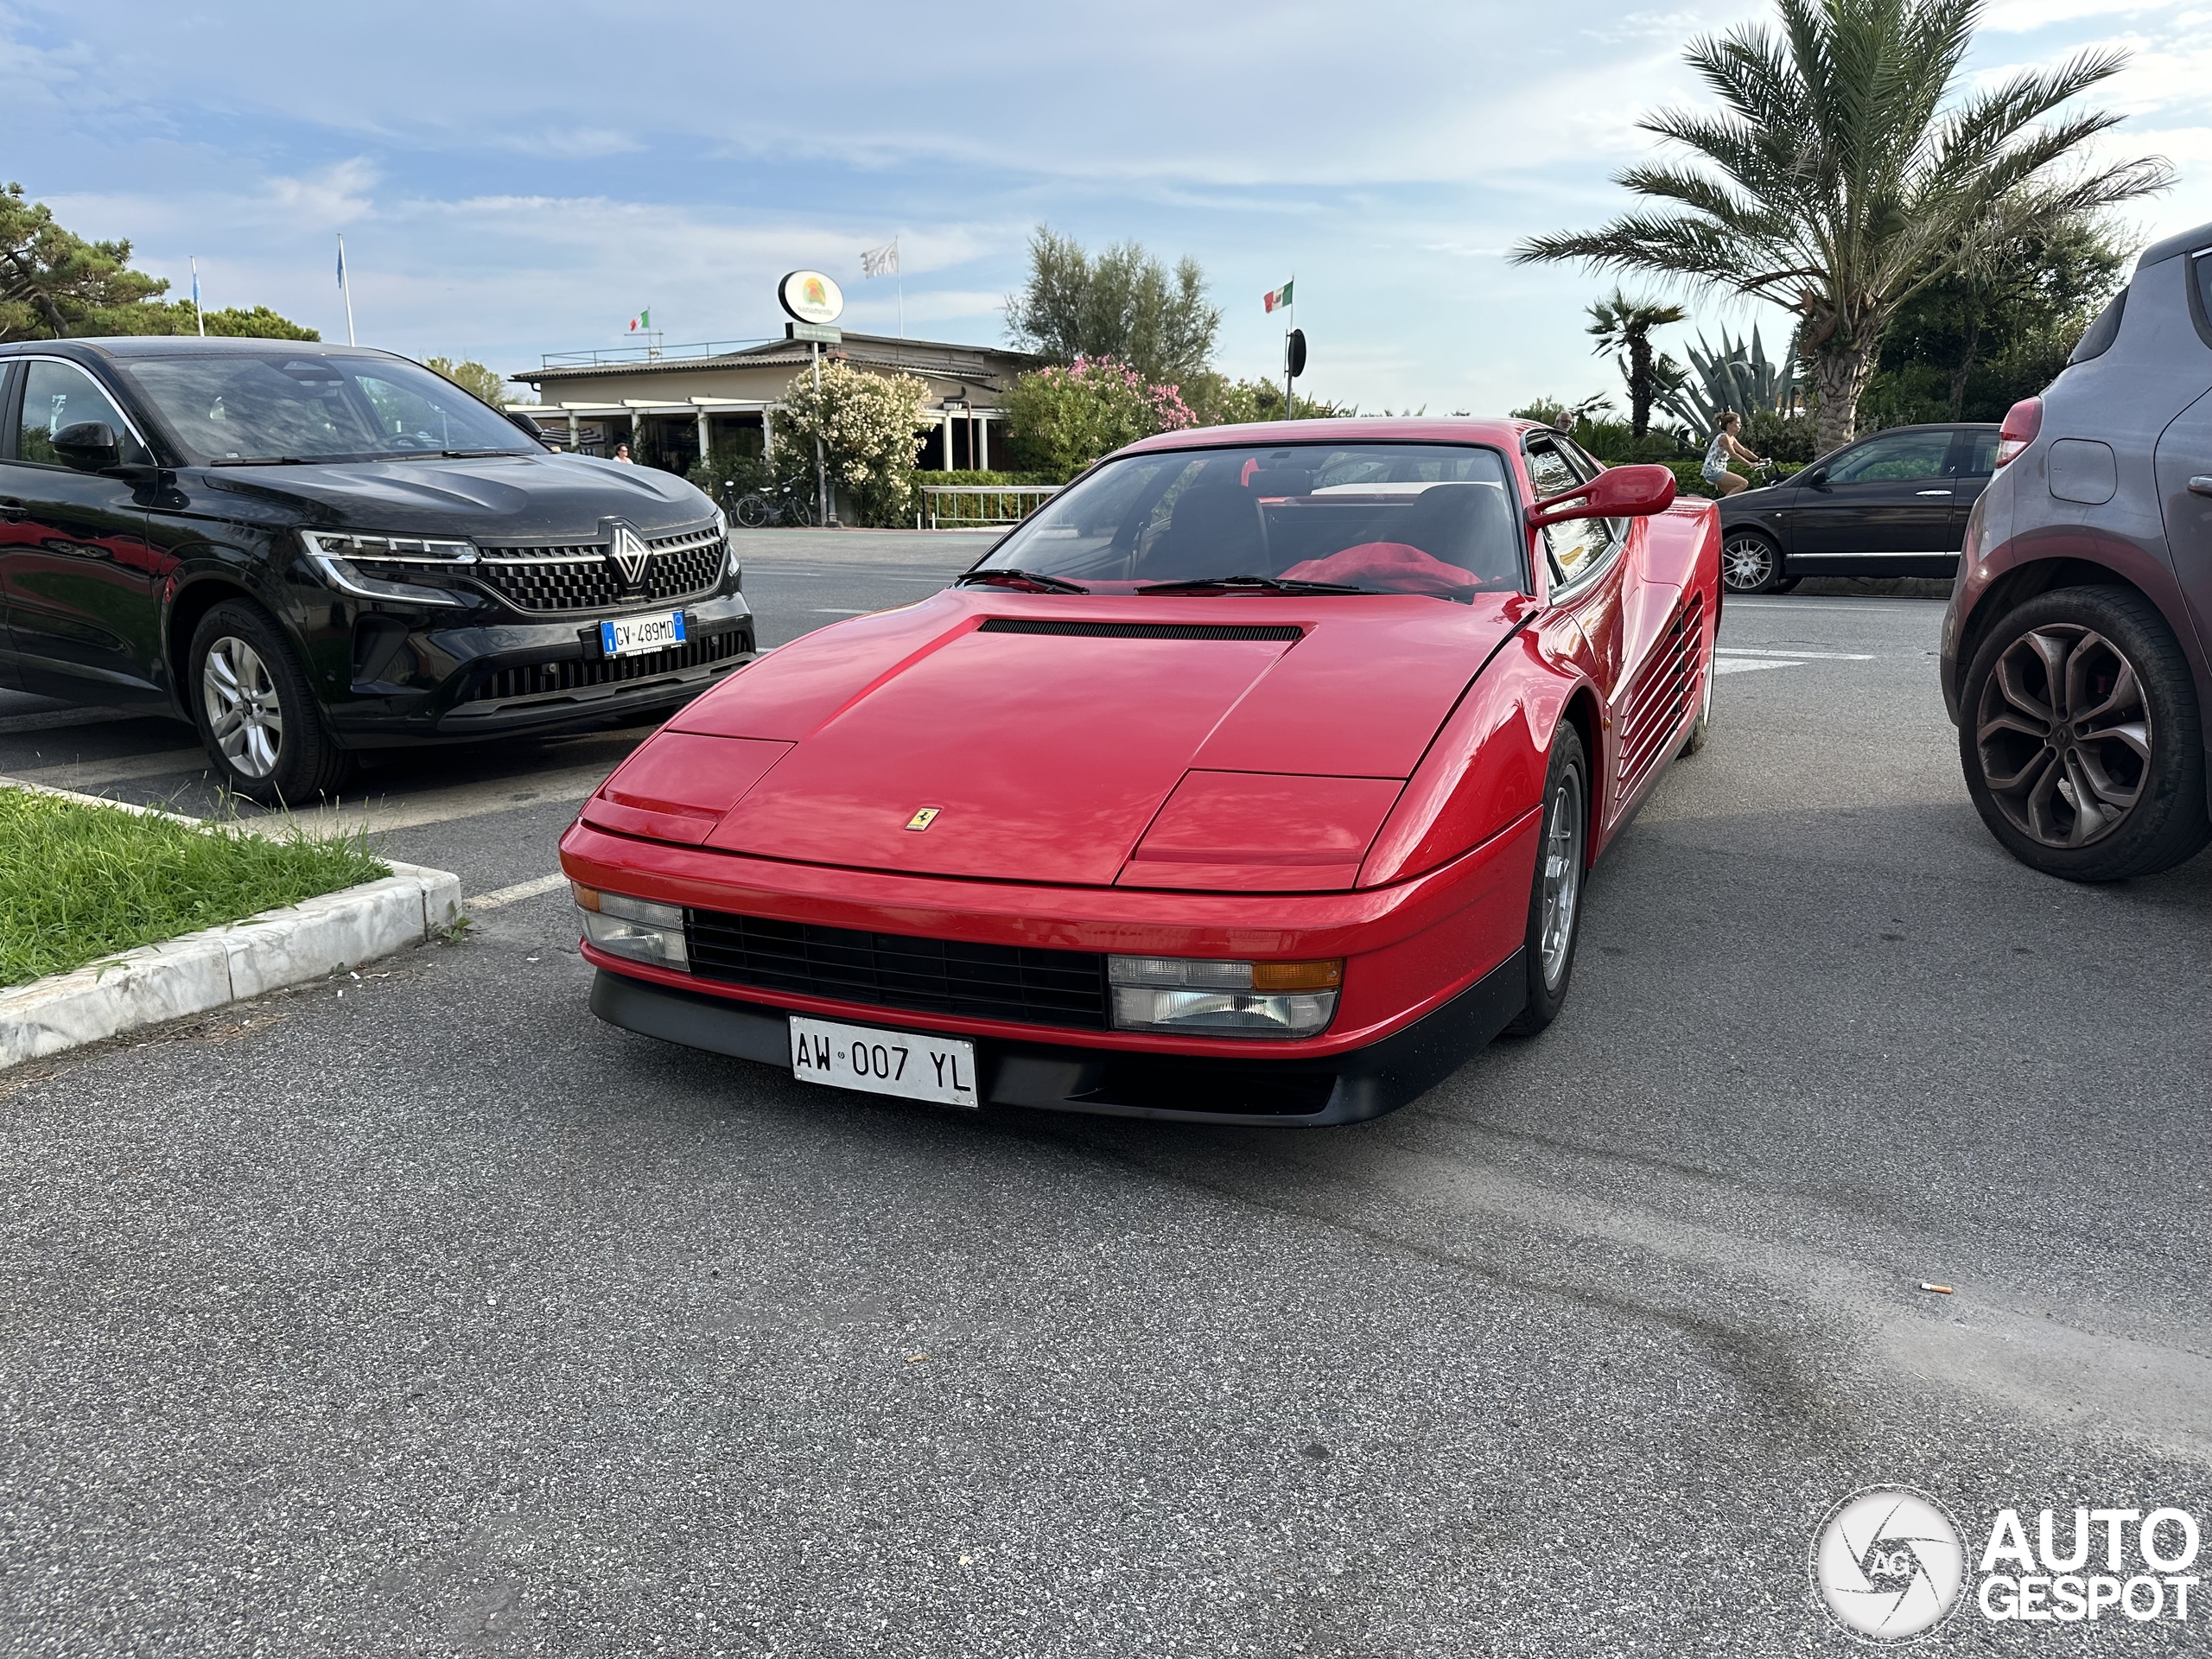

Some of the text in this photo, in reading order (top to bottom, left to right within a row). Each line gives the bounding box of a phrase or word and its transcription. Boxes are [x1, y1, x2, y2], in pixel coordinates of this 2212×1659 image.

[615, 626, 630, 645] GV
[638, 620, 674, 643] 489MD
[797, 1033, 971, 1091] AW 007 YL
